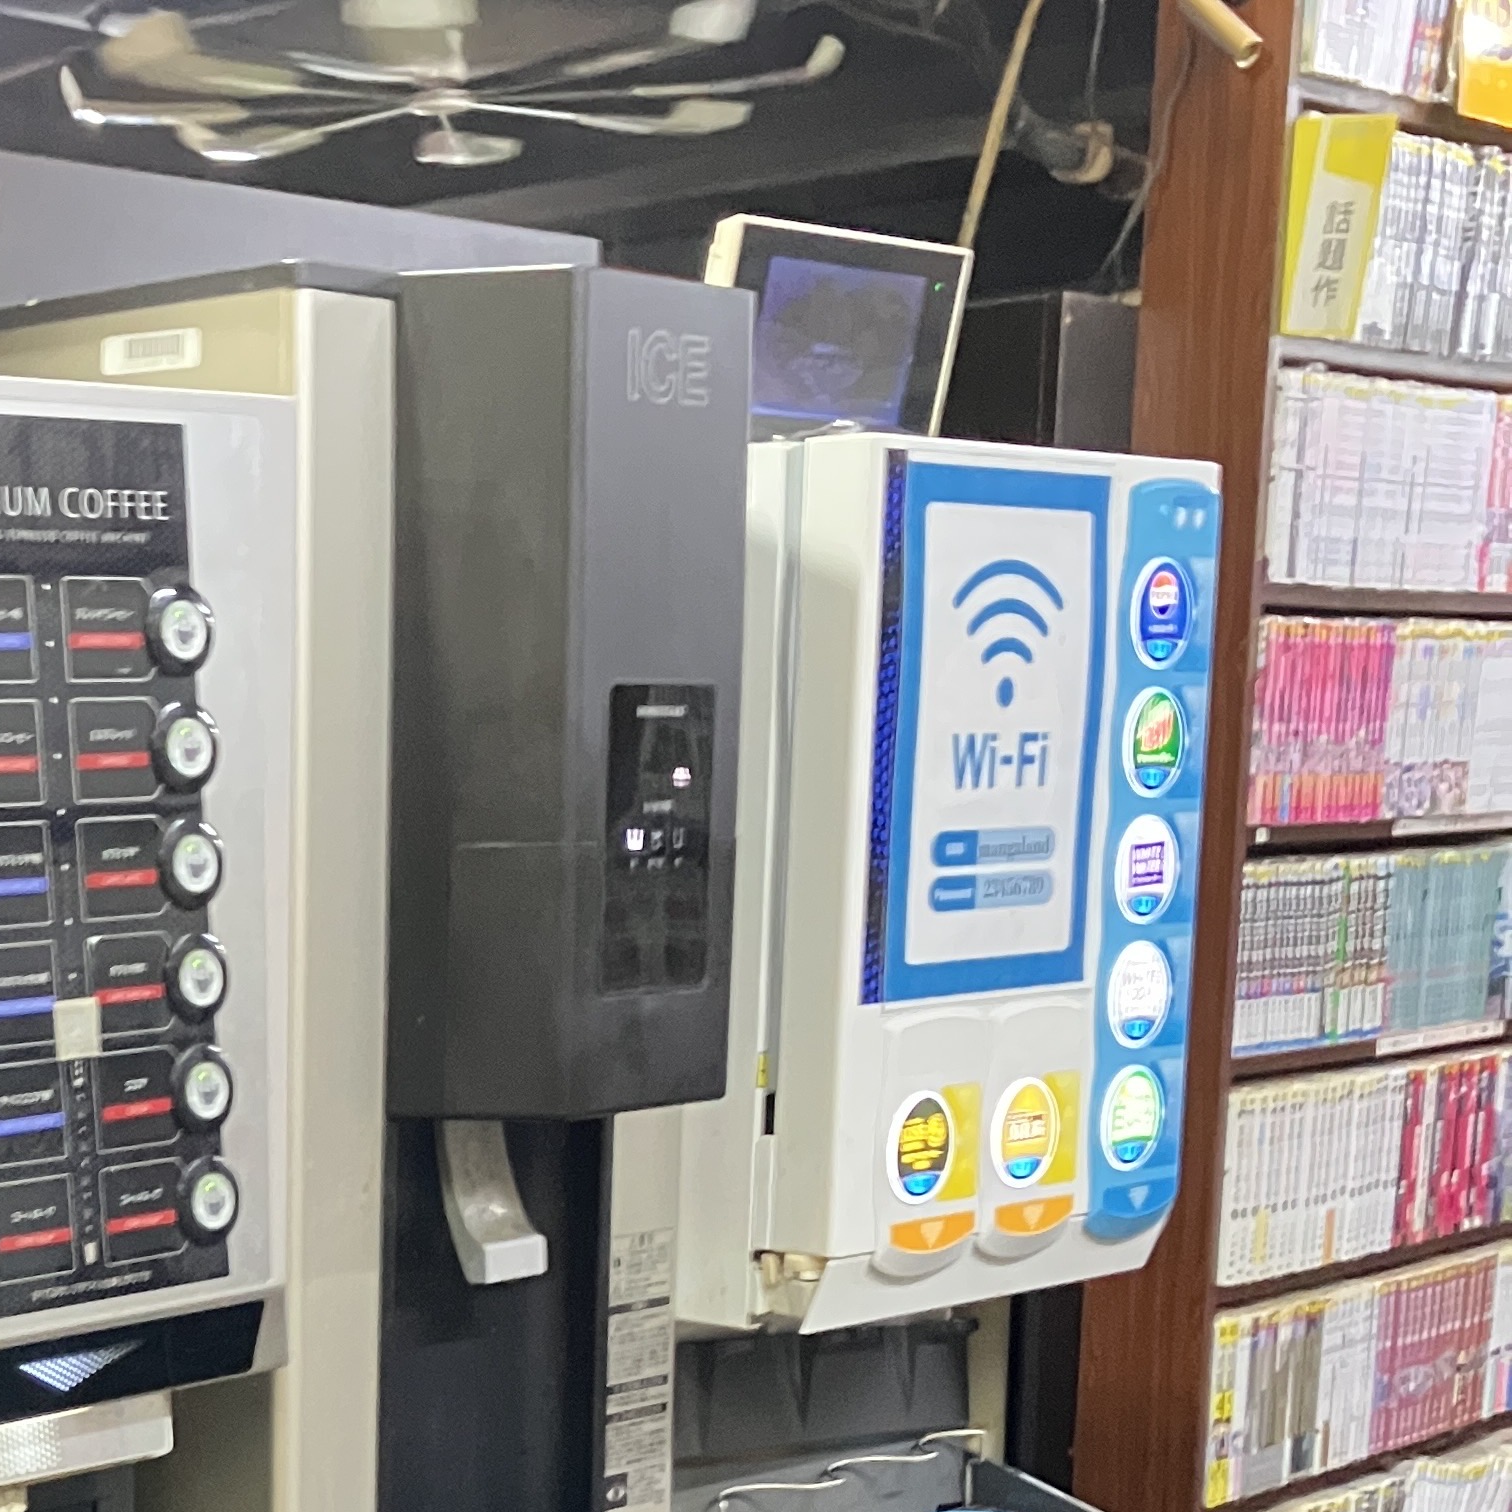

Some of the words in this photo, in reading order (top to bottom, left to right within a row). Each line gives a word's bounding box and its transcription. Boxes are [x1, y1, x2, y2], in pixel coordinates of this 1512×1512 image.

[626, 327, 711, 407] ICE
[58, 487, 172, 521] COFFEE
[951, 731, 1050, 791] Wi-Fi
